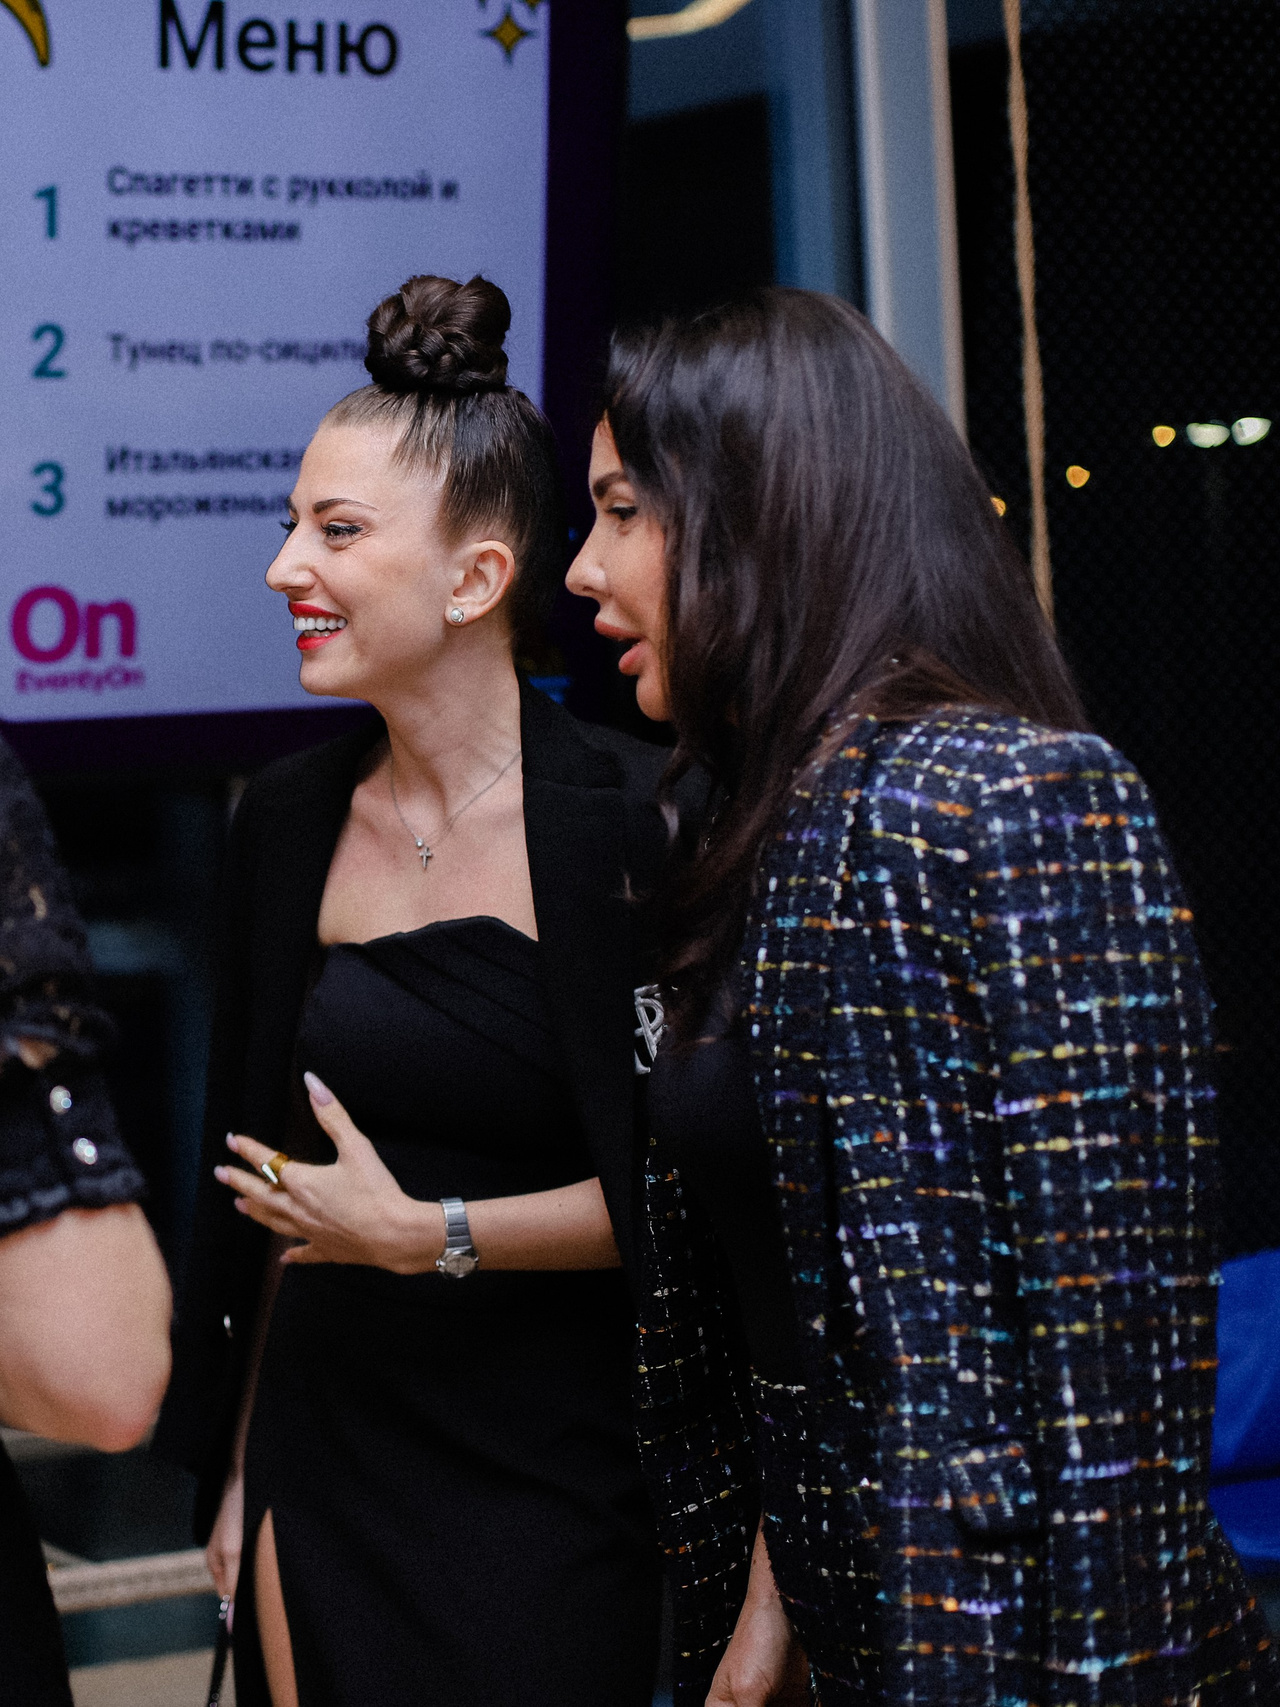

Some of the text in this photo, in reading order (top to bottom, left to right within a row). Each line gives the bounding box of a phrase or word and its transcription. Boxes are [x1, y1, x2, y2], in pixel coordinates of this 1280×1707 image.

[158, 0, 401, 75] Меню
[107, 166, 254, 198] Спагетти
[34, 185, 59, 239] 1
[107, 217, 300, 248] креветками
[31, 323, 67, 379] 2
[108, 332, 203, 371] Тунец
[30, 462, 66, 517] 3
[12, 586, 136, 664] On
